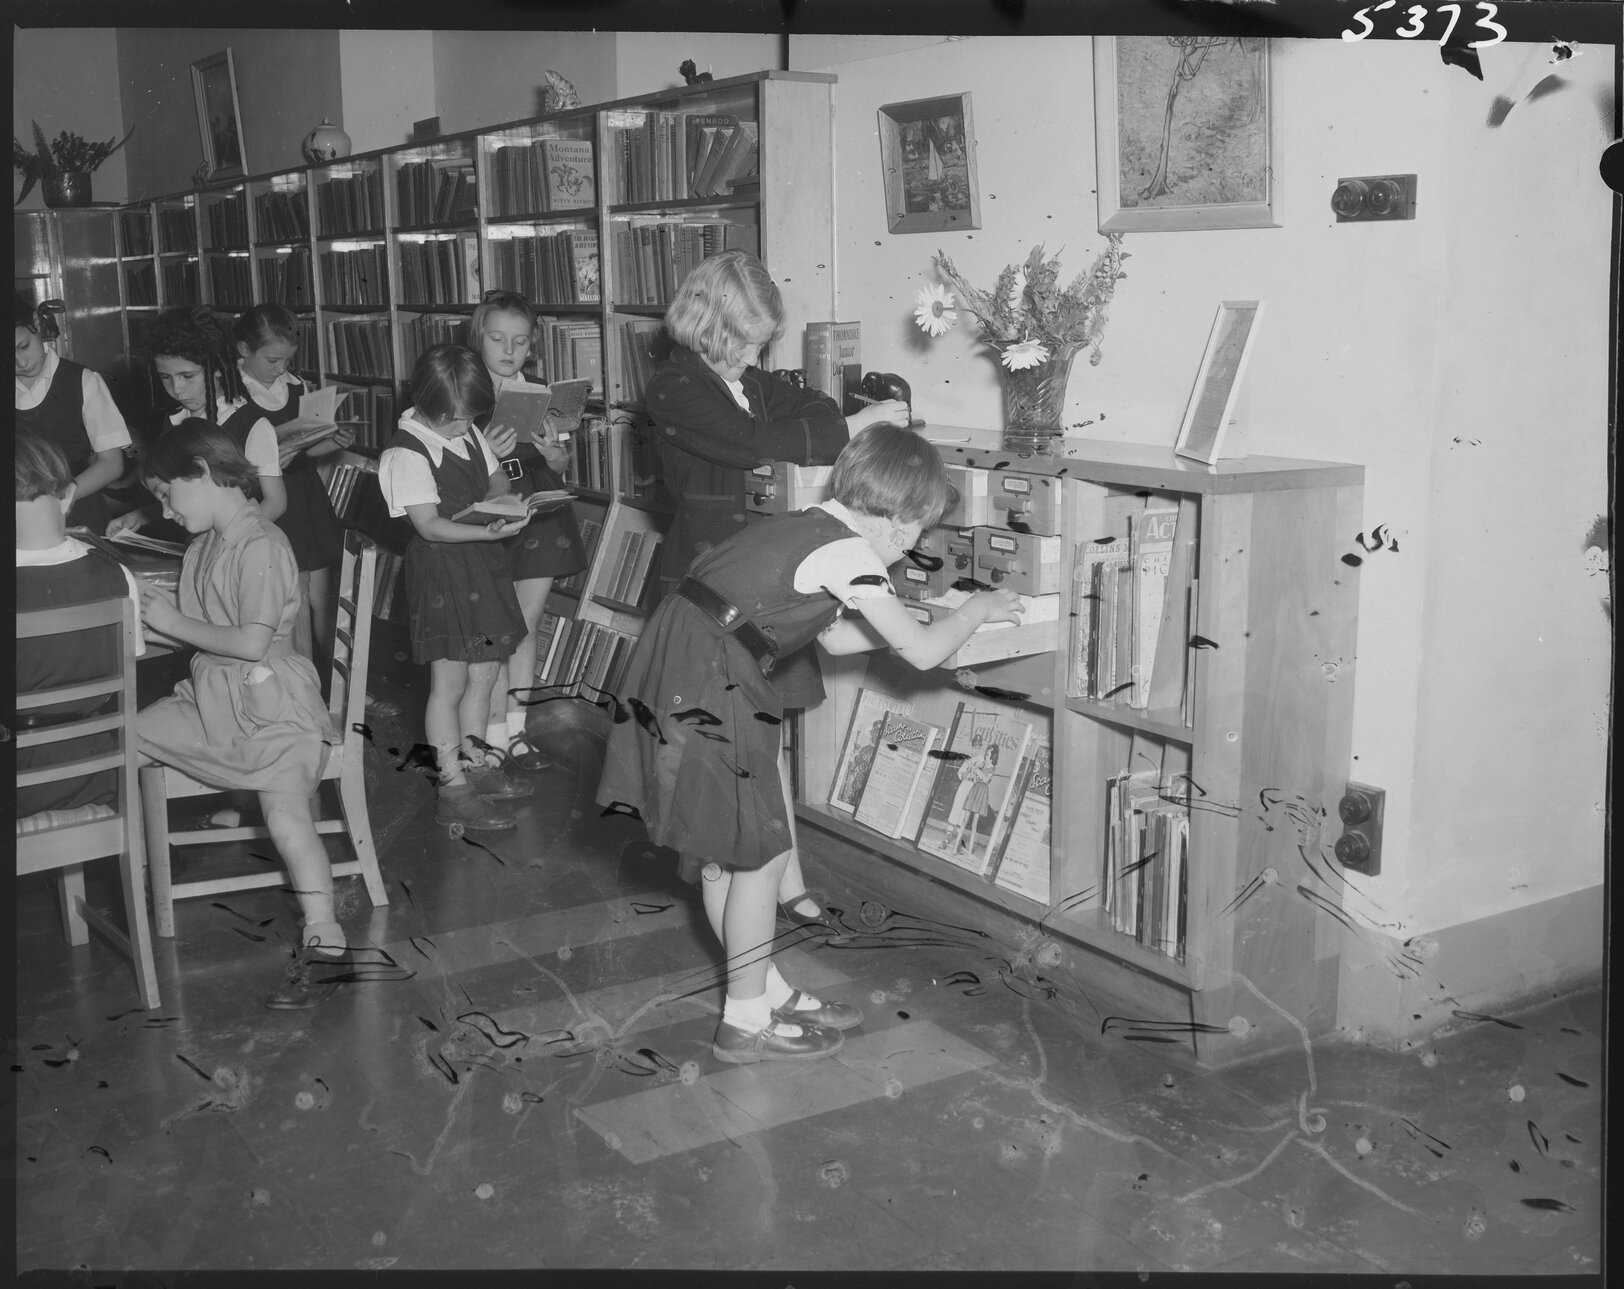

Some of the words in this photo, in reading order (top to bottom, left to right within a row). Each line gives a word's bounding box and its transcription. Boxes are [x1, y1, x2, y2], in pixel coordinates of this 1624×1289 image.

[1341, 0, 1507, 48] 5373
[695, 117, 730, 125] PENROD
[549, 143, 590, 154] Montana
[549, 154, 593, 163] Adventure
[1029, 773, 1051, 789] Sta
